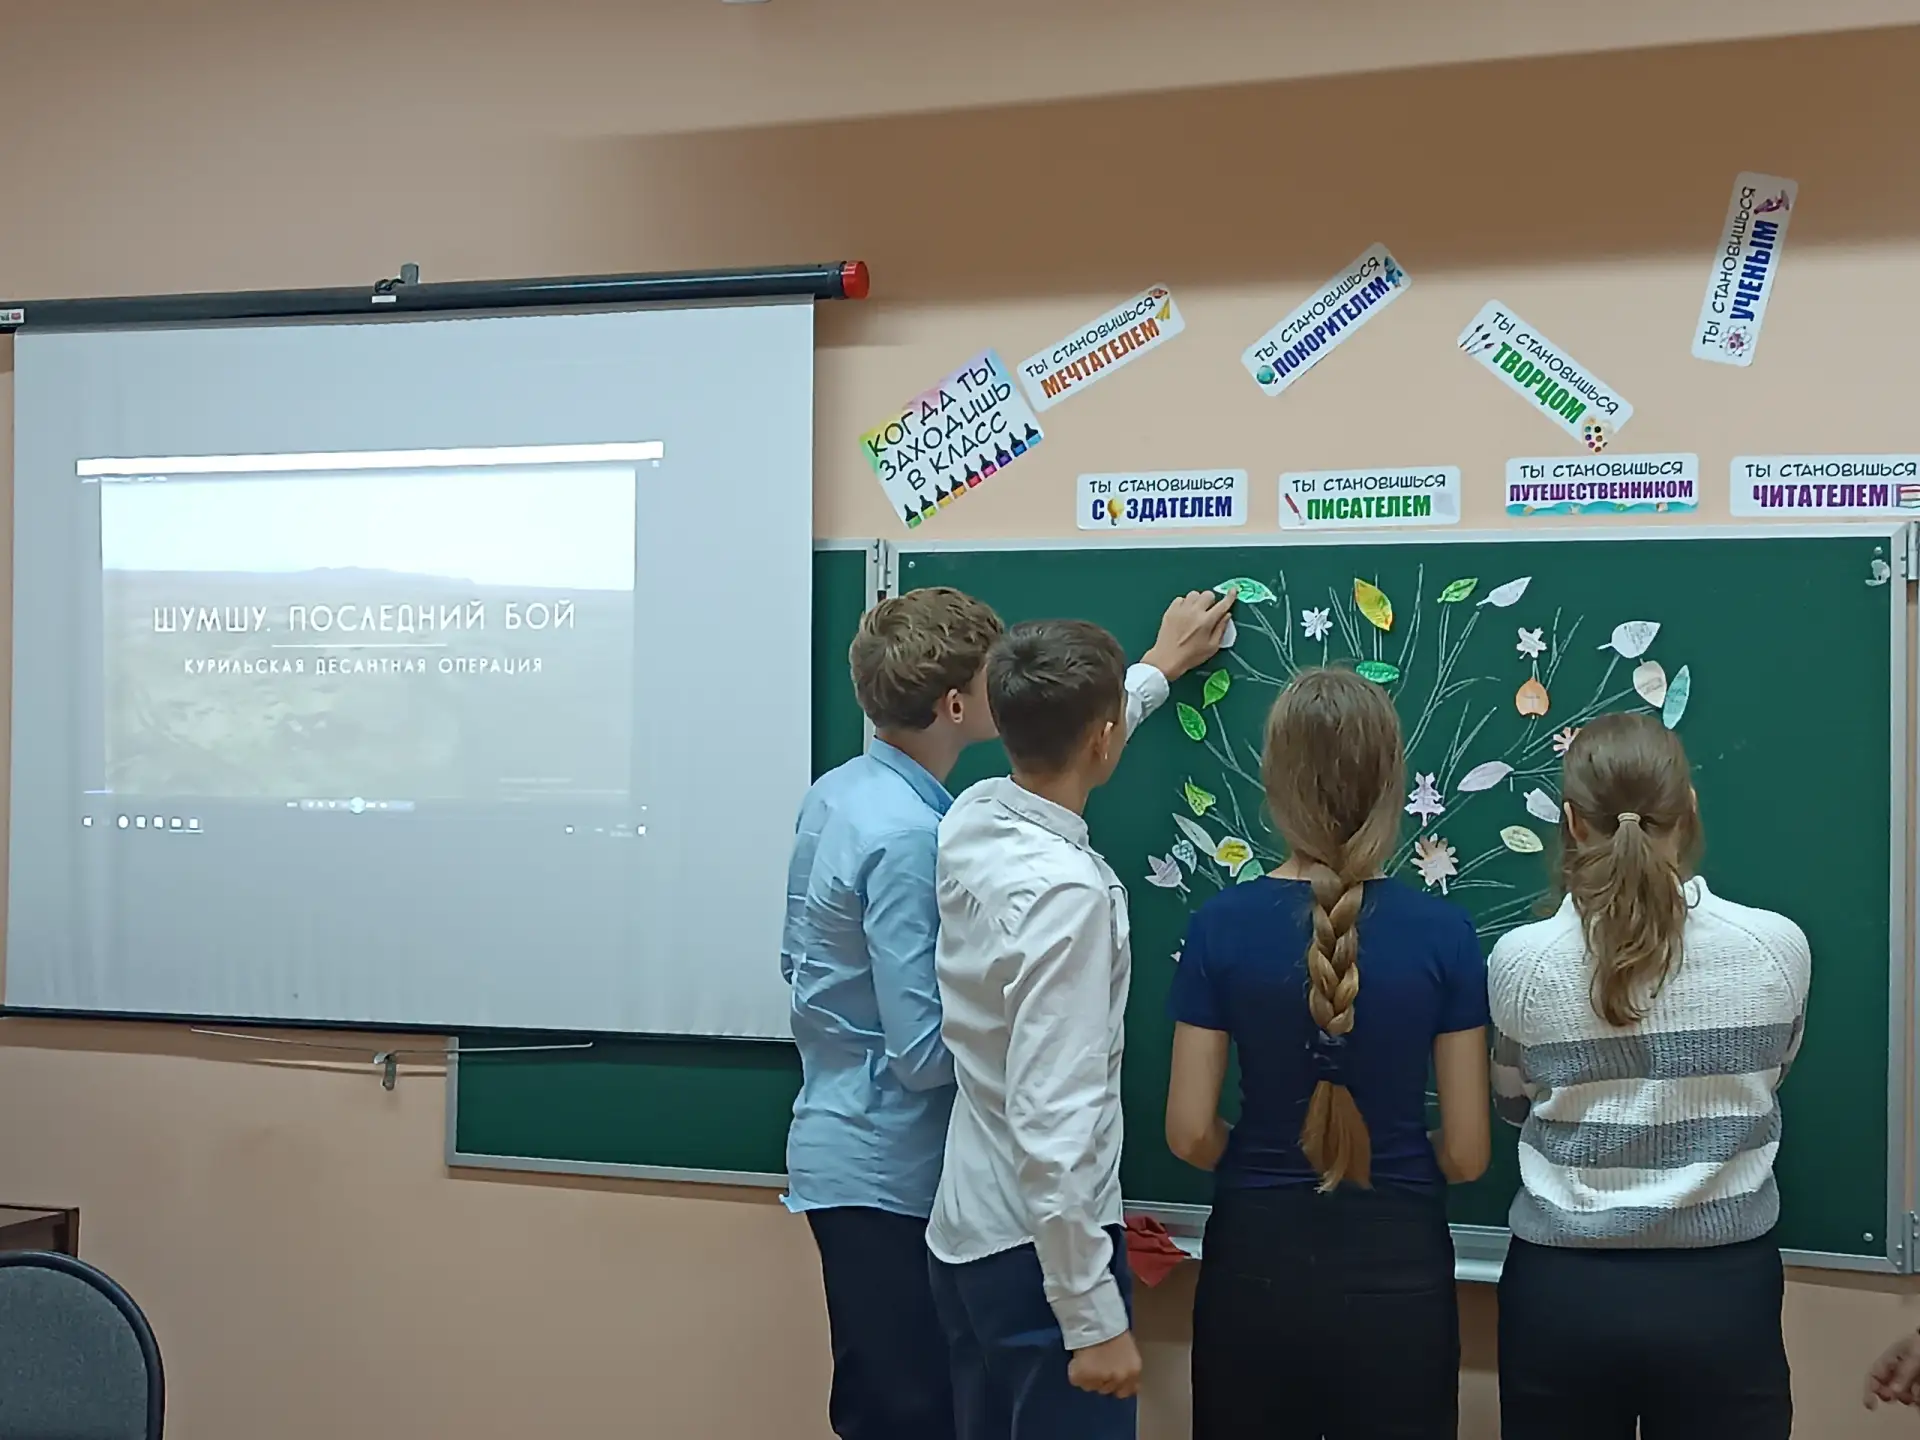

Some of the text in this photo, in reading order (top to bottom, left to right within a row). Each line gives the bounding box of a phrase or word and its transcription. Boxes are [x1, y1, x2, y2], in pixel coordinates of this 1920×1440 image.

[1702, 186, 1757, 345] ТЫ СТАНОВИШЬСЯ
[1729, 220, 1779, 322] УЧЕНЫМ
[1025, 296, 1156, 378] ТЫ СТАНОВИШЬСЯ
[1254, 256, 1381, 362] ТЫ СТАНОВИШЬСЯ
[1271, 276, 1390, 378] ПОКОРИТЕЛЕМ
[1040, 317, 1160, 399] МЕЧТАТЕЛЕМ
[1492, 311, 1620, 416] ТЫ СТАНОВИШЬСЯ
[1492, 341, 1587, 424] ТВОРЦОМ
[867, 357, 997, 458] КОГДА ТЫ
[878, 382, 1011, 481] ЗАХОДИШЬ
[906, 410, 1008, 491] В КЛАСС
[1089, 476, 1234, 493] ТЫ СТАНОВИШЬСЯ
[1292, 473, 1446, 493] ТЫ СТАНОВИШЬСЯ
[1509, 480, 1693, 502] ПУТЕШЕСТВЕННИКОМ
[1519, 461, 1683, 478] ТЫ СТАНОВИШЬСЯ
[1745, 462, 1917, 478] ТЫ СТАНОВИШЬСЯ
[1091, 495, 1233, 523] СЗДАТЕЛЕМ
[1307, 494, 1432, 520] ПИСАТЕЛЕМ
[1753, 484, 1889, 508] ЧИТАТЕЛЕМ
[153, 599, 575, 634] ШУМШУ. ПОСЛЕДНИЙ БОЙ
[184, 657, 542, 675] КУРИЛЬСКАЯ ДЕСАНТНАЯ ОПЕРАЦИЯ
